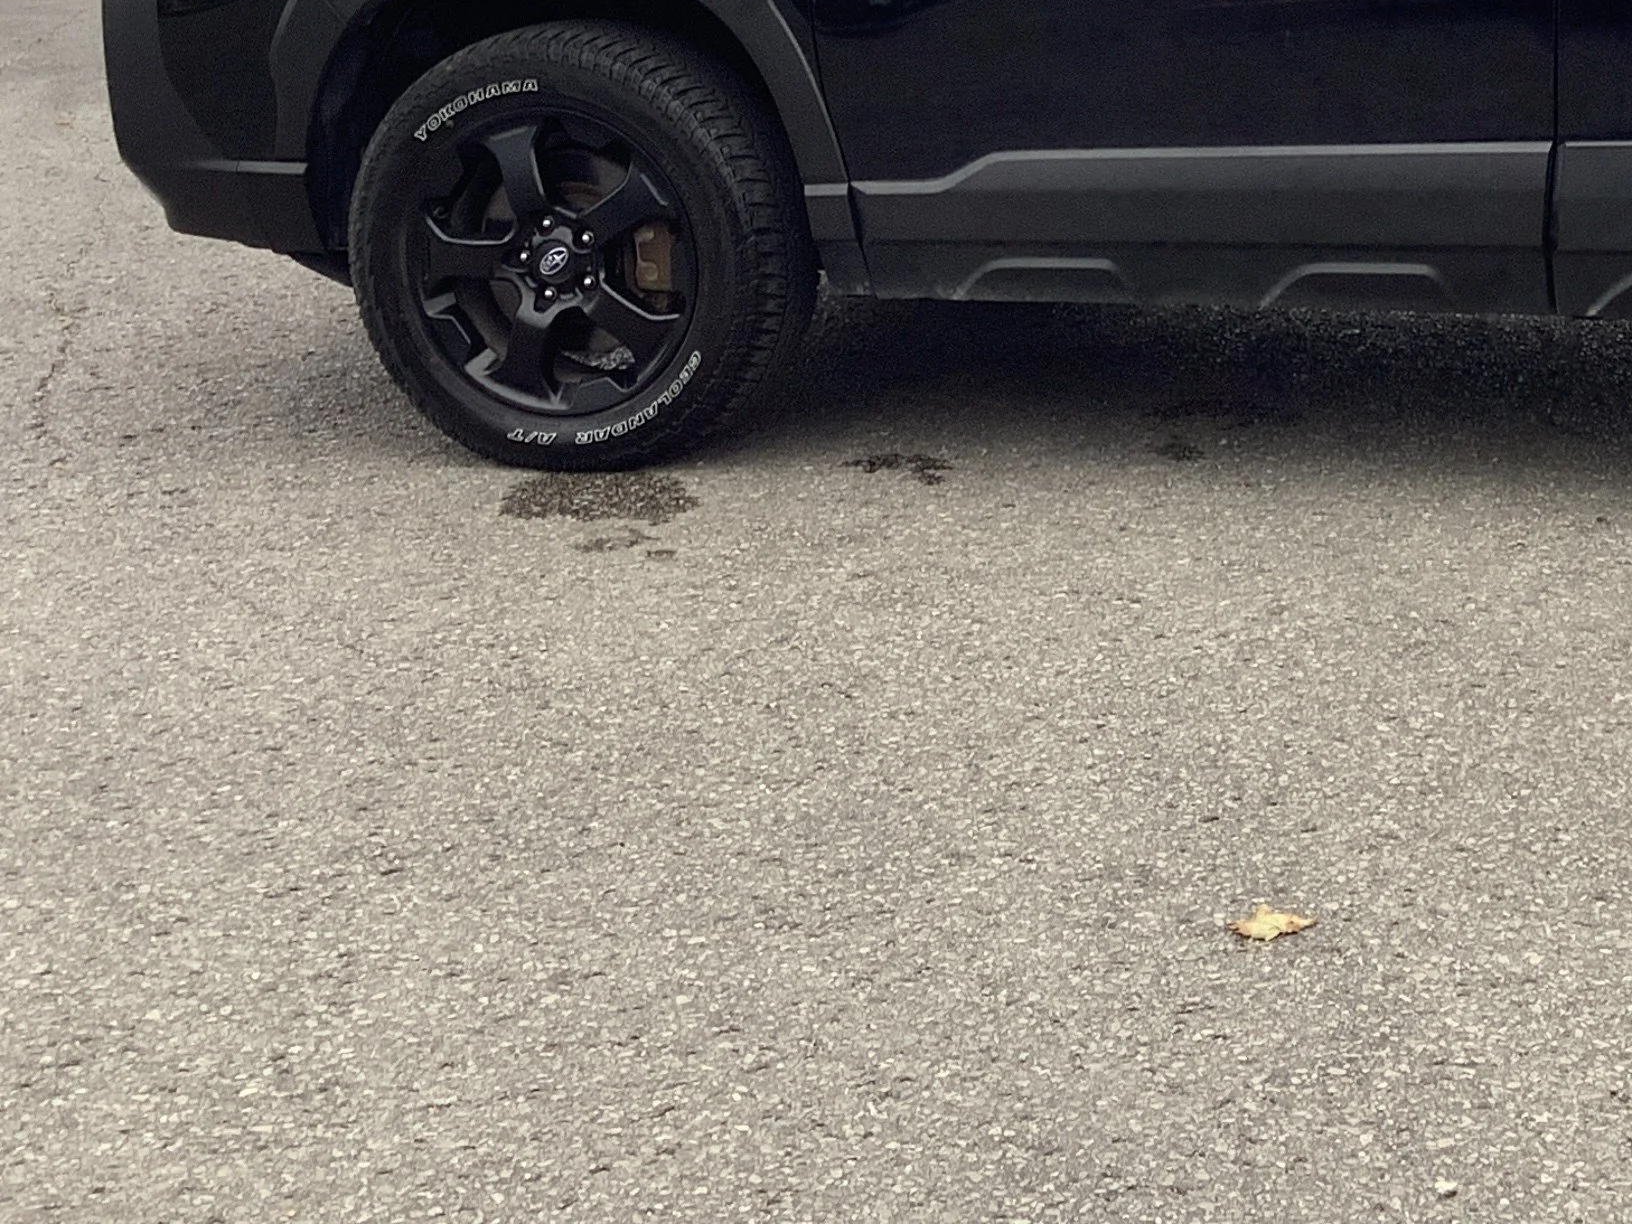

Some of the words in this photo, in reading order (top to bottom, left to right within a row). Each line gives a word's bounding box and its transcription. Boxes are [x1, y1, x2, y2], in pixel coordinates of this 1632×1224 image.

[414, 79, 538, 142] YOKOHAMA
[575, 350, 702, 445] GEOLANDAR
[507, 428, 557, 445] A/T
